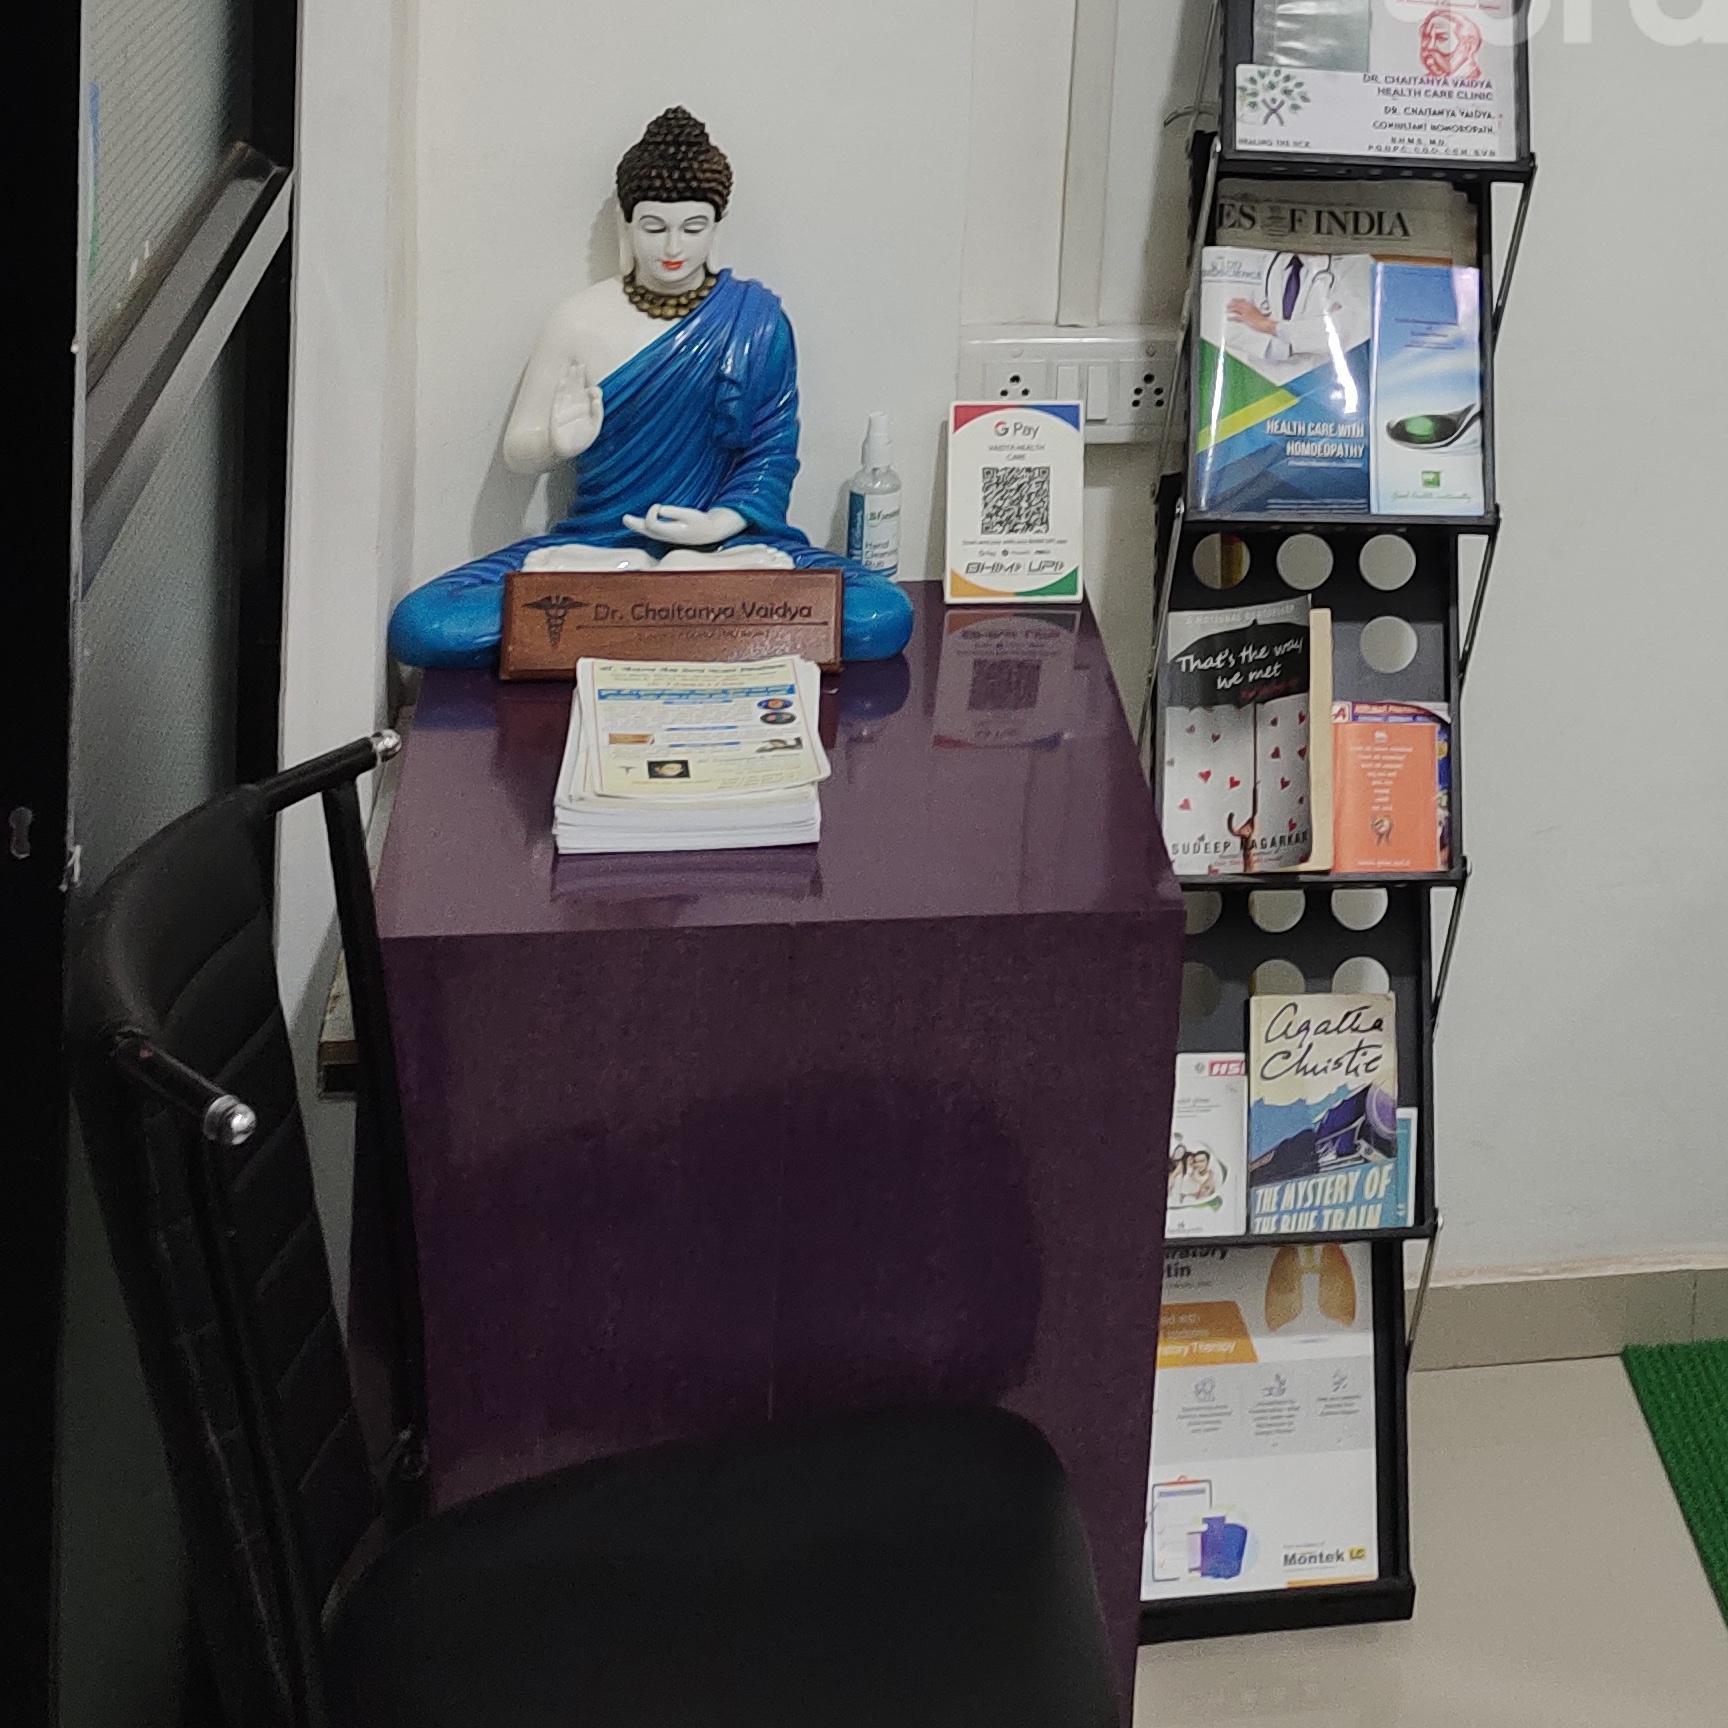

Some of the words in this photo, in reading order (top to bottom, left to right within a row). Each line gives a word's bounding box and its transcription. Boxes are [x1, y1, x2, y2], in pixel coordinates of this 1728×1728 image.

[1384, 75, 1450, 87] CHAITANYA
[1451, 79, 1493, 89] VAIDYA
[1376, 86, 1422, 98] HEALTH
[1424, 88, 1454, 99] CARE
[1456, 91, 1494, 101] CLINIC
[1403, 106, 1457, 118] CHAITANYA
[1372, 120, 1427, 131] CONSULTANT
[1312, 209, 1411, 237] INDIA
[994, 421, 1009, 437] G
[1012, 422, 1040, 441] Pay
[1265, 419, 1306, 437] HEALTH
[1307, 421, 1336, 437] CARE
[1337, 423, 1365, 438] WITH
[1286, 440, 1365, 459] HOMOEOPATHY
[592, 603, 623, 621] Dr.
[630, 602, 735, 622] Chaitanya
[741, 601, 813, 622] Vaidya
[1175, 648, 1236, 673] That's
[1238, 643, 1270, 664] the
[1216, 671, 1245, 690] we
[1248, 661, 1282, 683] met
[1171, 840, 1232, 855] SUDEEP
[1264, 1001, 1384, 1049] Agatha
[1259, 1038, 1384, 1081] Christie
[1255, 1185, 1281, 1215] THE
[1279, 1169, 1361, 1212] MYSTERY
[1363, 1162, 1394, 1201] OF
[1253, 1214, 1280, 1235] THE
[1320, 1203, 1383, 1232] TRAIN
[1282, 1547, 1345, 1567] Montek
